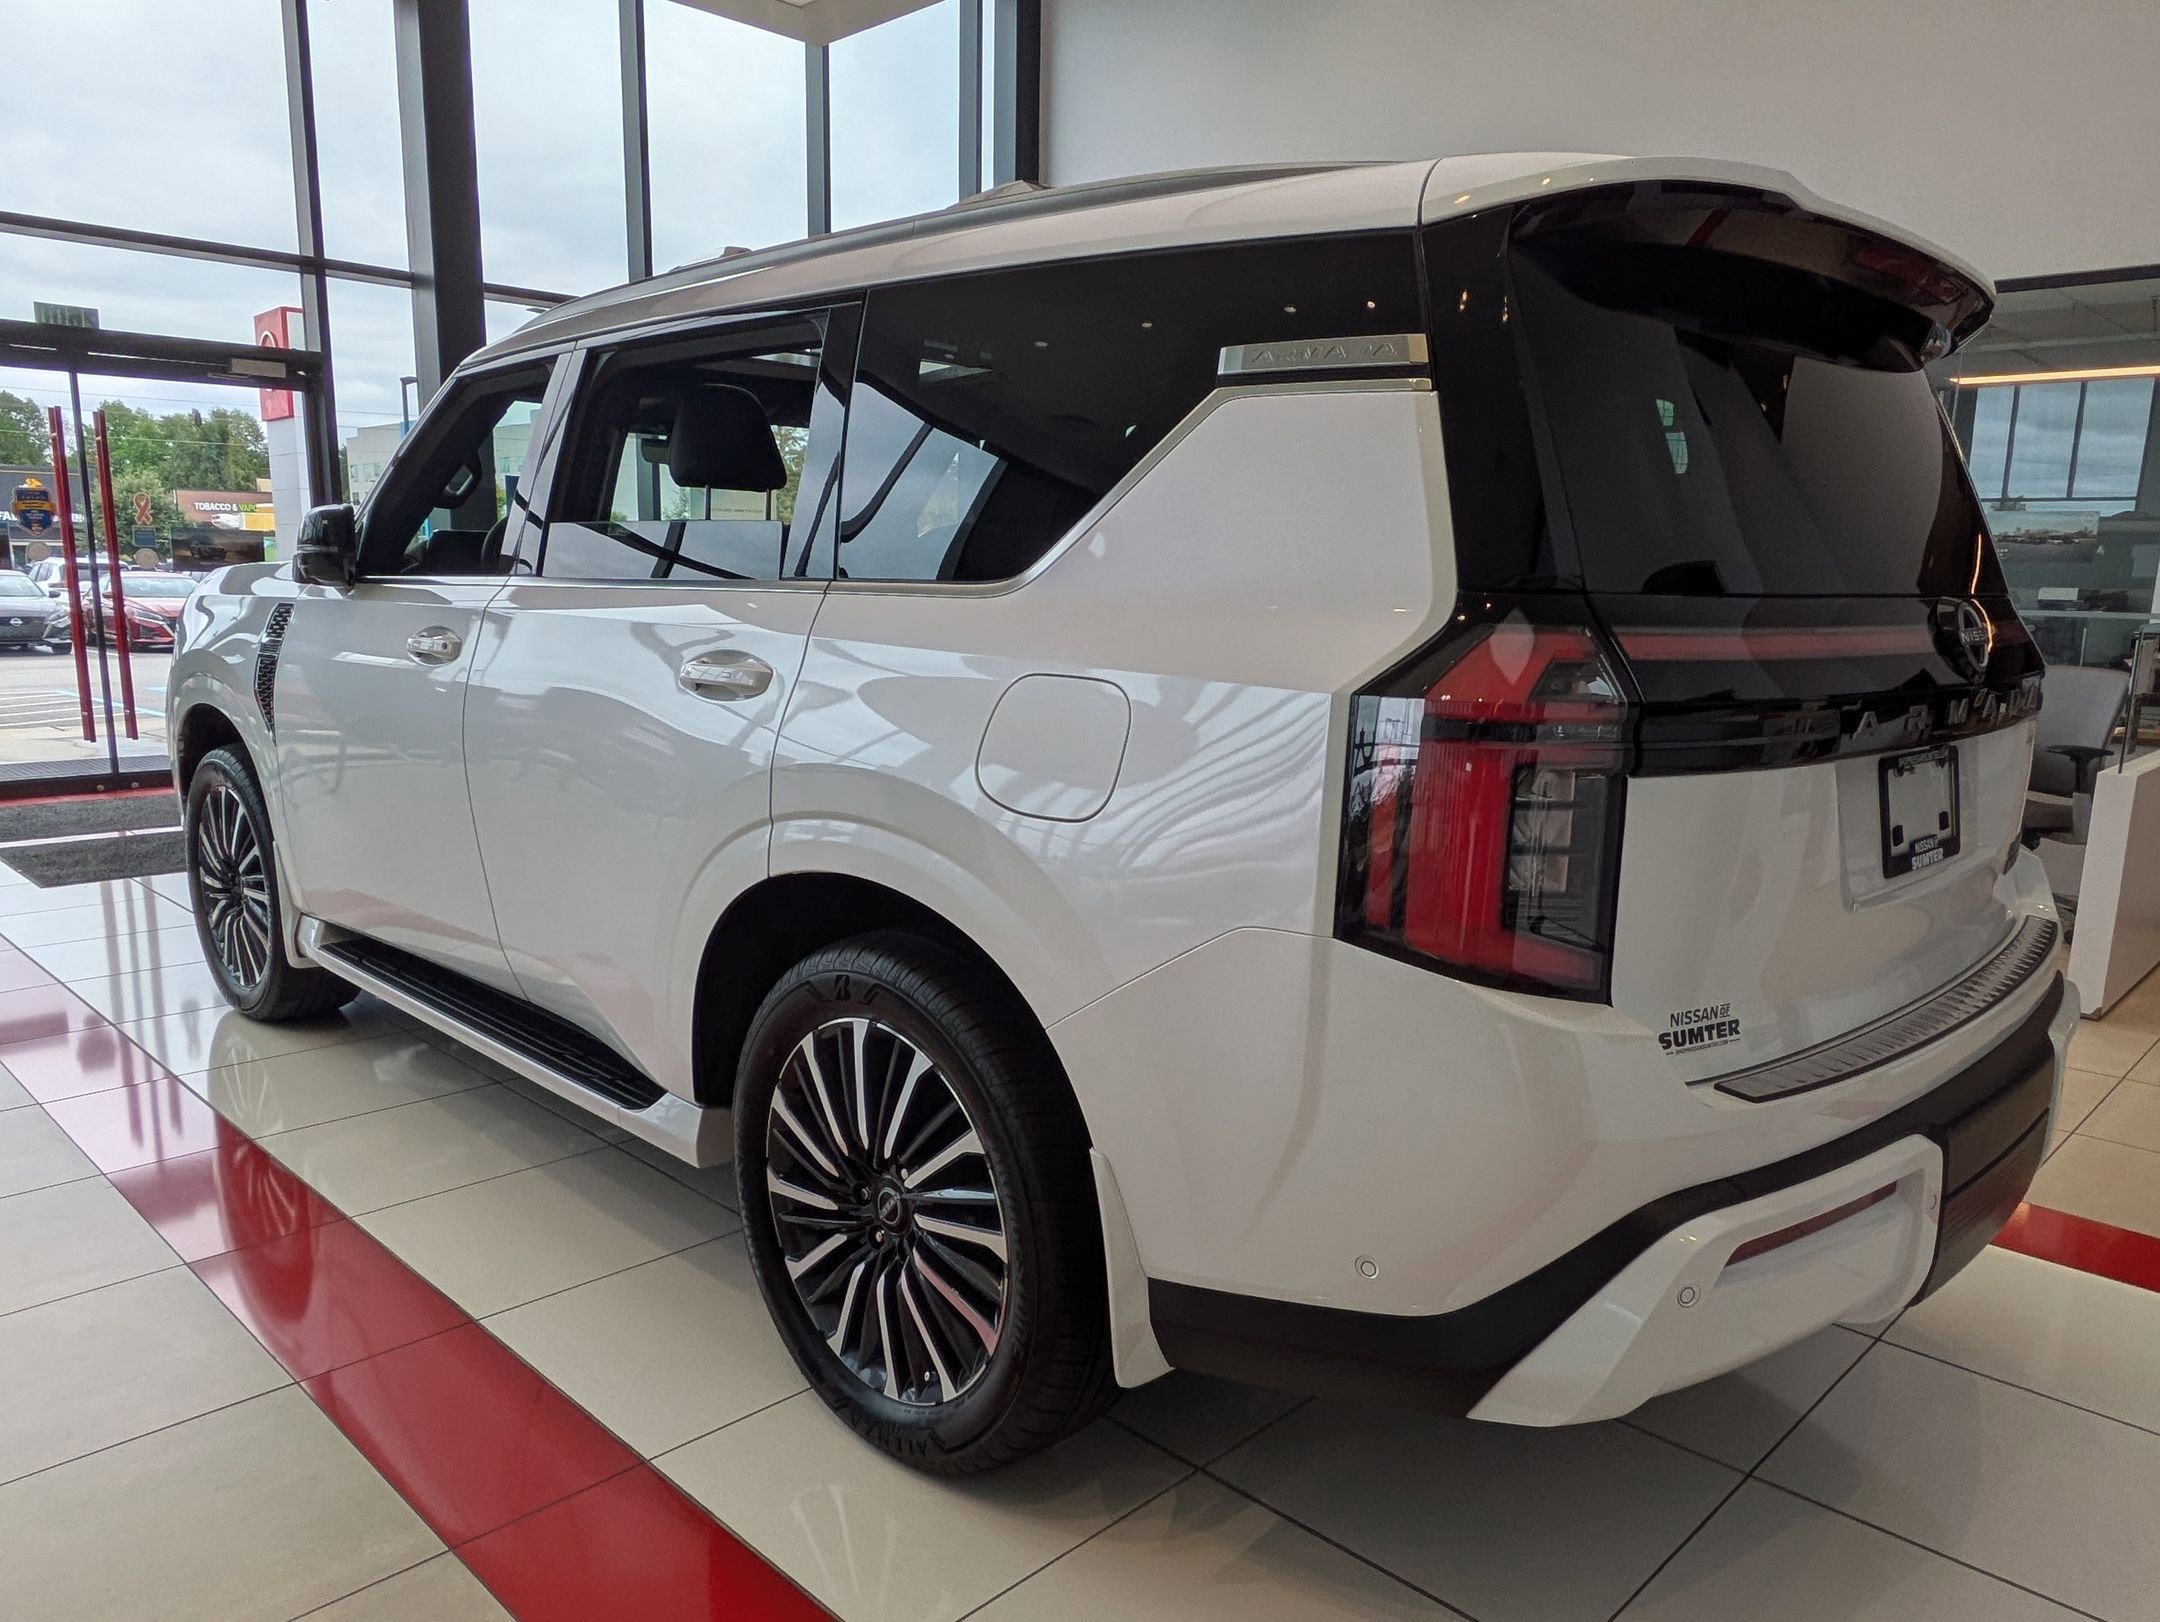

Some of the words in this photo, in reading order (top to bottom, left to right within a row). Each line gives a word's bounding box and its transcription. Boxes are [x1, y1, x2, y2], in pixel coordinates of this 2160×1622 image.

[194, 502, 231, 511] TOBACCO
[232, 503, 238, 511] &
[1960, 629, 1987, 642] NISS
[1911, 848, 1943, 870] SUMTER
[1670, 1005, 1719, 1027] NISSAN
[1720, 1005, 1730, 1016] OF
[1658, 1019, 1740, 1050] SUMTER
